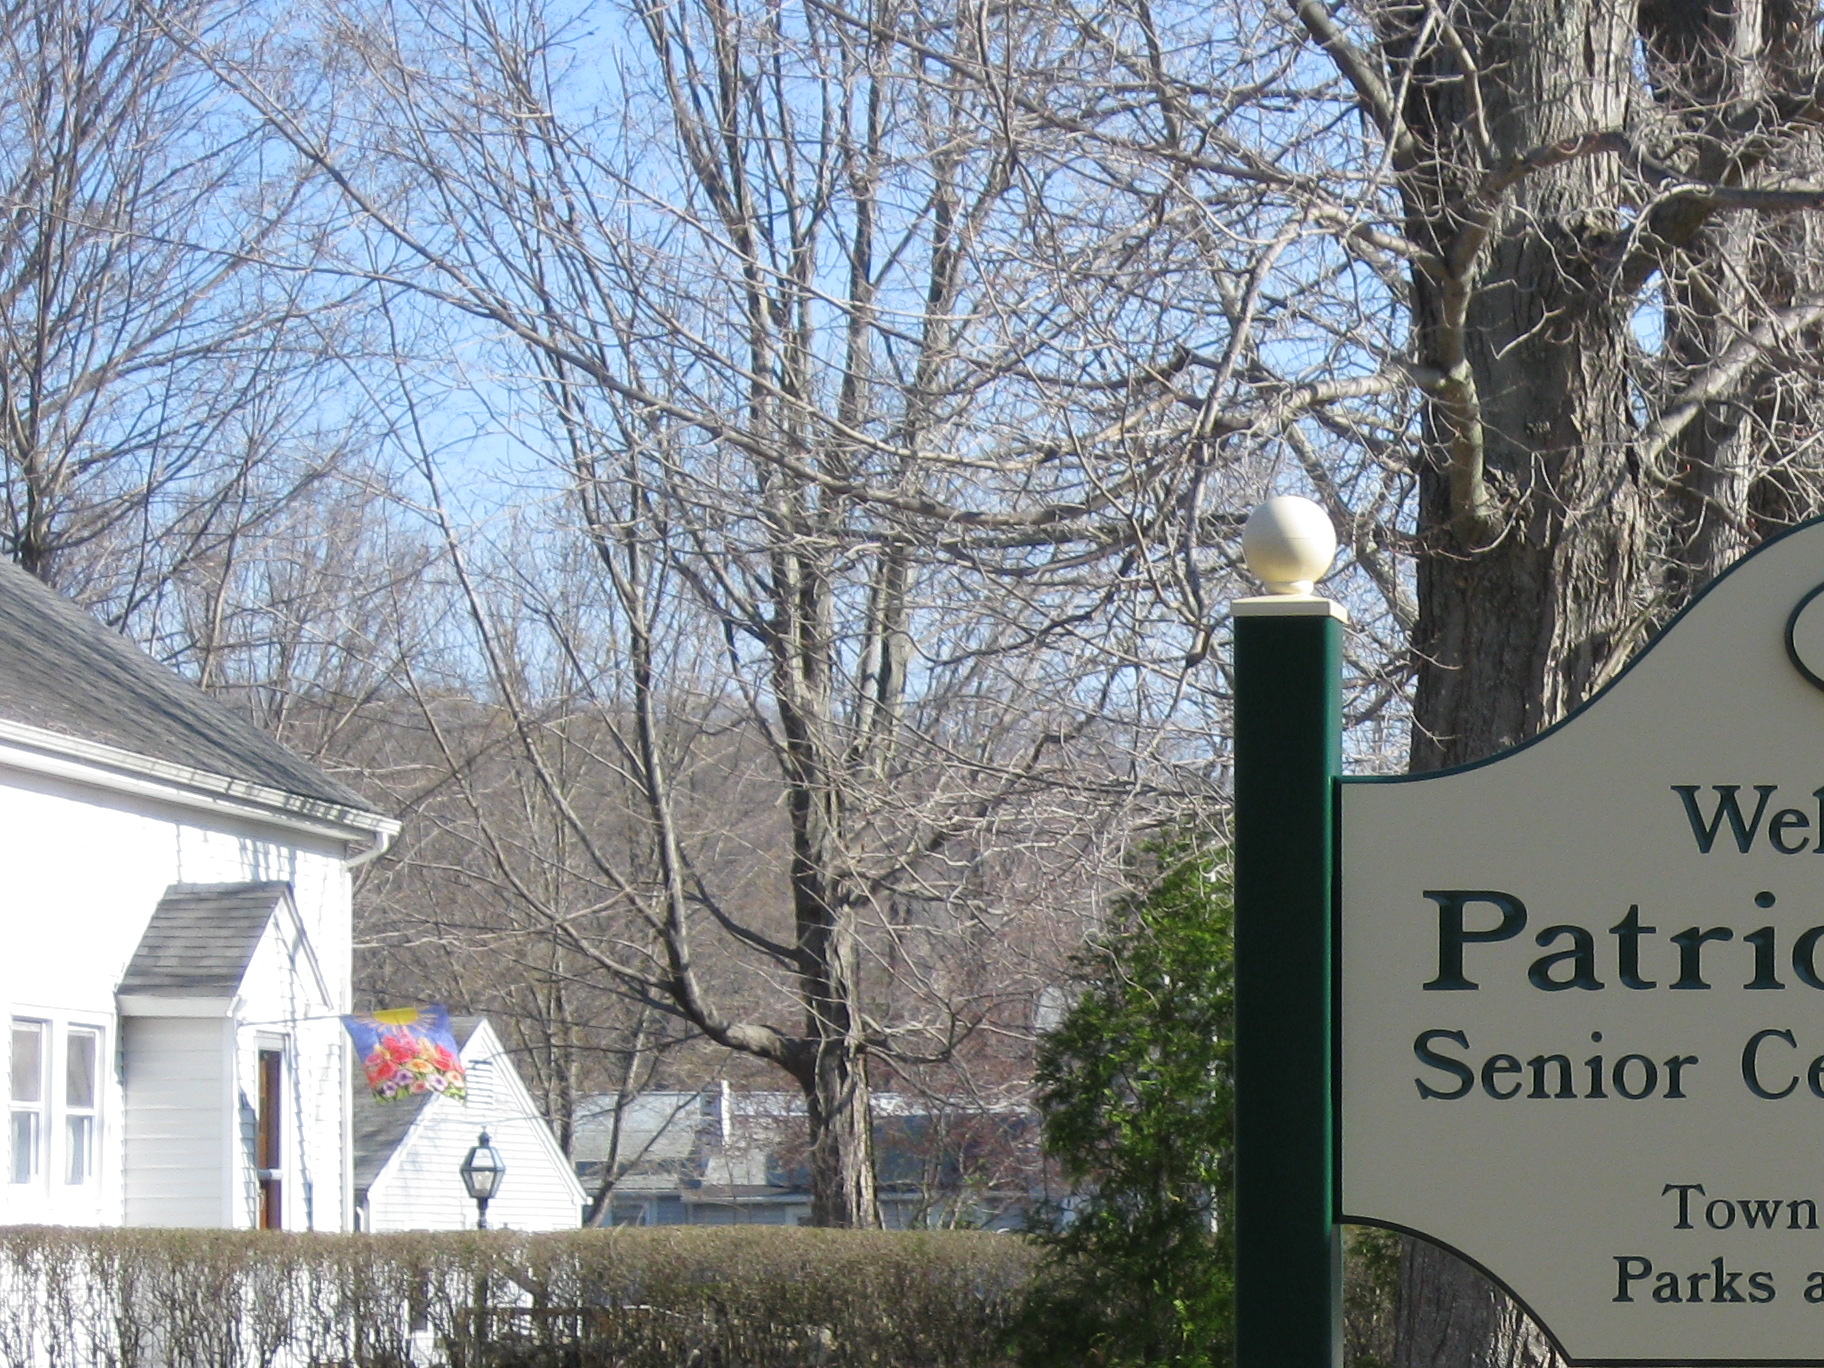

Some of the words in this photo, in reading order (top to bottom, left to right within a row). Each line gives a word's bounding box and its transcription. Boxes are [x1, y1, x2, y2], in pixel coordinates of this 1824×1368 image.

[1412, 1028, 1700, 1101] Senior
[1660, 1182, 1821, 1231] Town
[1611, 1255, 1777, 1304] Parks
